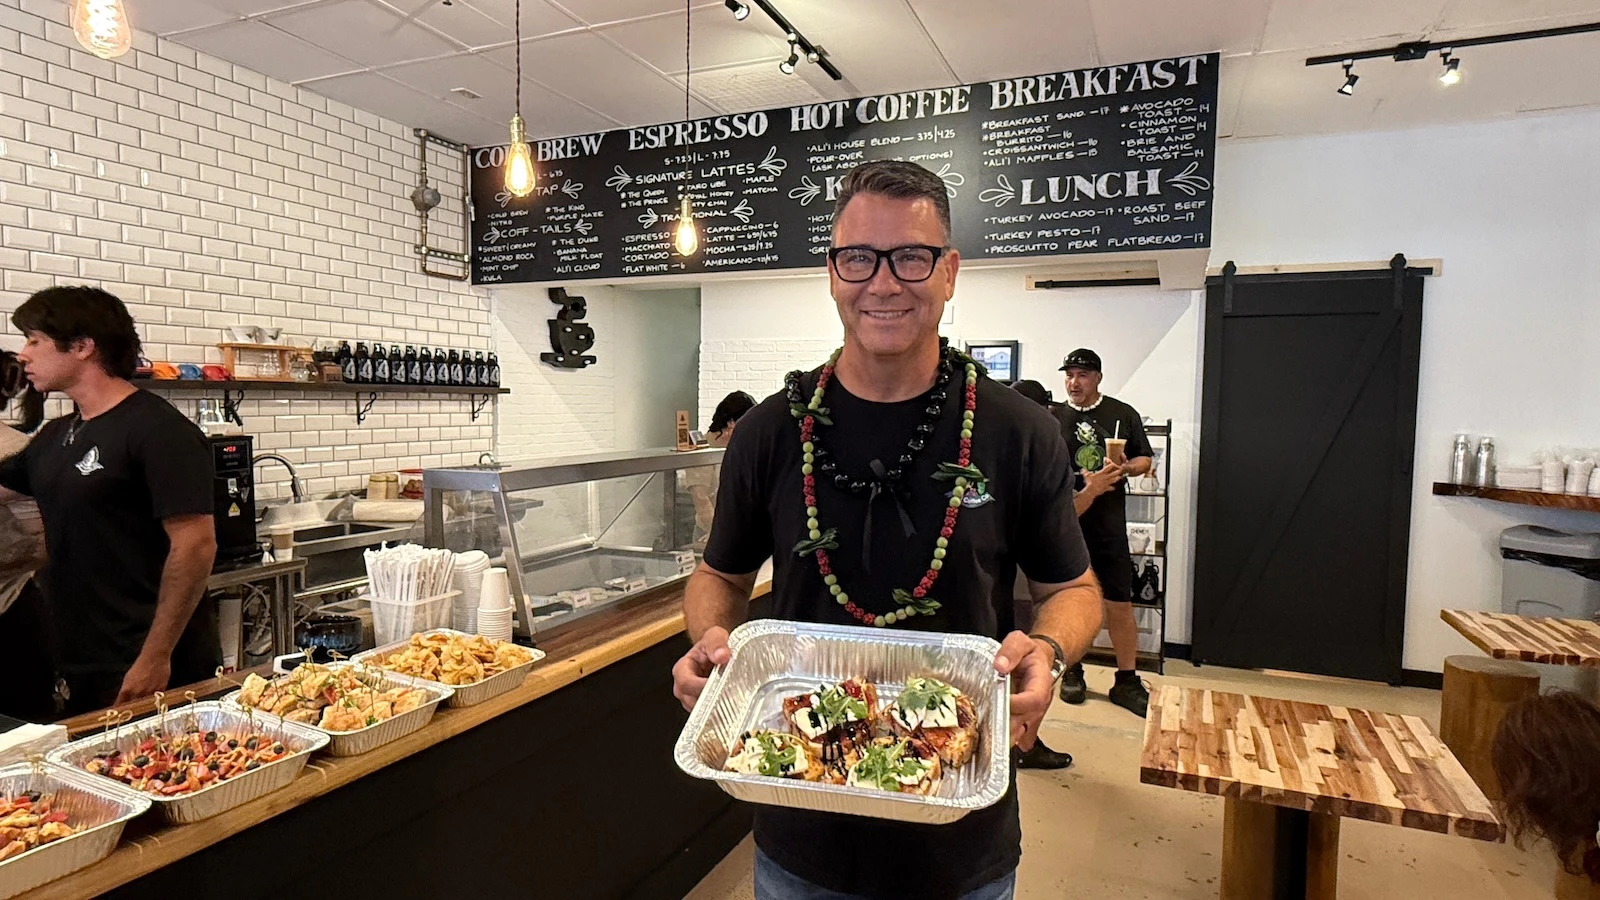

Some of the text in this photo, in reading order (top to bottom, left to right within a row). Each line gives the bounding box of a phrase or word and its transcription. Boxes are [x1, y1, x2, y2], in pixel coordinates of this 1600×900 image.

[988, 55, 1208, 110] BREAKFAST
[790, 85, 972, 132] HOT COFFEE
[1130, 97, 1194, 112] AVOCADO
[1138, 103, 1210, 119] TOAST 14
[988, 115, 1049, 130] BREAKFAST
[1100, 106, 1110, 115] 17
[1128, 115, 1197, 129] CINNAMON
[628, 111, 769, 151] ESPRESSO
[988, 125, 1051, 141] BREAKFAST
[1138, 121, 1207, 136] TOAST 14
[833, 139, 866, 151] HOUSE
[870, 135, 901, 147] BLEND
[996, 130, 1073, 147] BURRITO 16
[1126, 133, 1196, 148] BRIE AND
[475, 132, 607, 169] CO BREW
[987, 138, 1098, 156] CROISSANTWICH 16
[1127, 142, 1193, 157] BALSAMIC
[909, 150, 954, 162] OPTIONS)
[1016, 151, 1075, 164] MAFFLES
[1138, 149, 1204, 163] TOAST 14
[635, 162, 756, 184] SIGNATURE LATTES
[745, 175, 775, 184] MAPLE
[535, 184, 559, 196] TAP
[709, 190, 734, 198] HONEY
[745, 186, 778, 195] MATCHA
[1020, 168, 1162, 206] LUNCH
[568, 204, 586, 212] KING
[643, 197, 669, 206] PRINCE
[1123, 200, 1206, 215] ROAST BEEF
[990, 214, 1033, 225] TURKEY
[1038, 209, 1096, 221] AVOCADO
[1185, 212, 1195, 222] 17
[500, 226, 530, 238] COFF
[539, 223, 572, 234] TAILS
[706, 221, 779, 233] CAPPUCCINO 6
[989, 225, 1101, 242] TURKEY PESTO 17
[625, 231, 671, 243] ESPRESSO
[706, 234, 736, 243] LATTE
[990, 232, 1205, 254] PROSCIUTTO PEAR FLATBREAD 17
[556, 247, 588, 256] BANANA
[625, 242, 671, 253] MACCHIATO
[705, 245, 736, 255] MOCHA
[482, 254, 514, 263] ALMOND
[580, 252, 604, 260] FLOAT
[624, 251, 670, 262] CORTADO
[704, 257, 754, 267] AMERICANO
[482, 264, 500, 272] MINT
[573, 262, 601, 272] CLOUD
[625, 265, 645, 274] FLAT
[645, 263, 669, 272] WHITE
